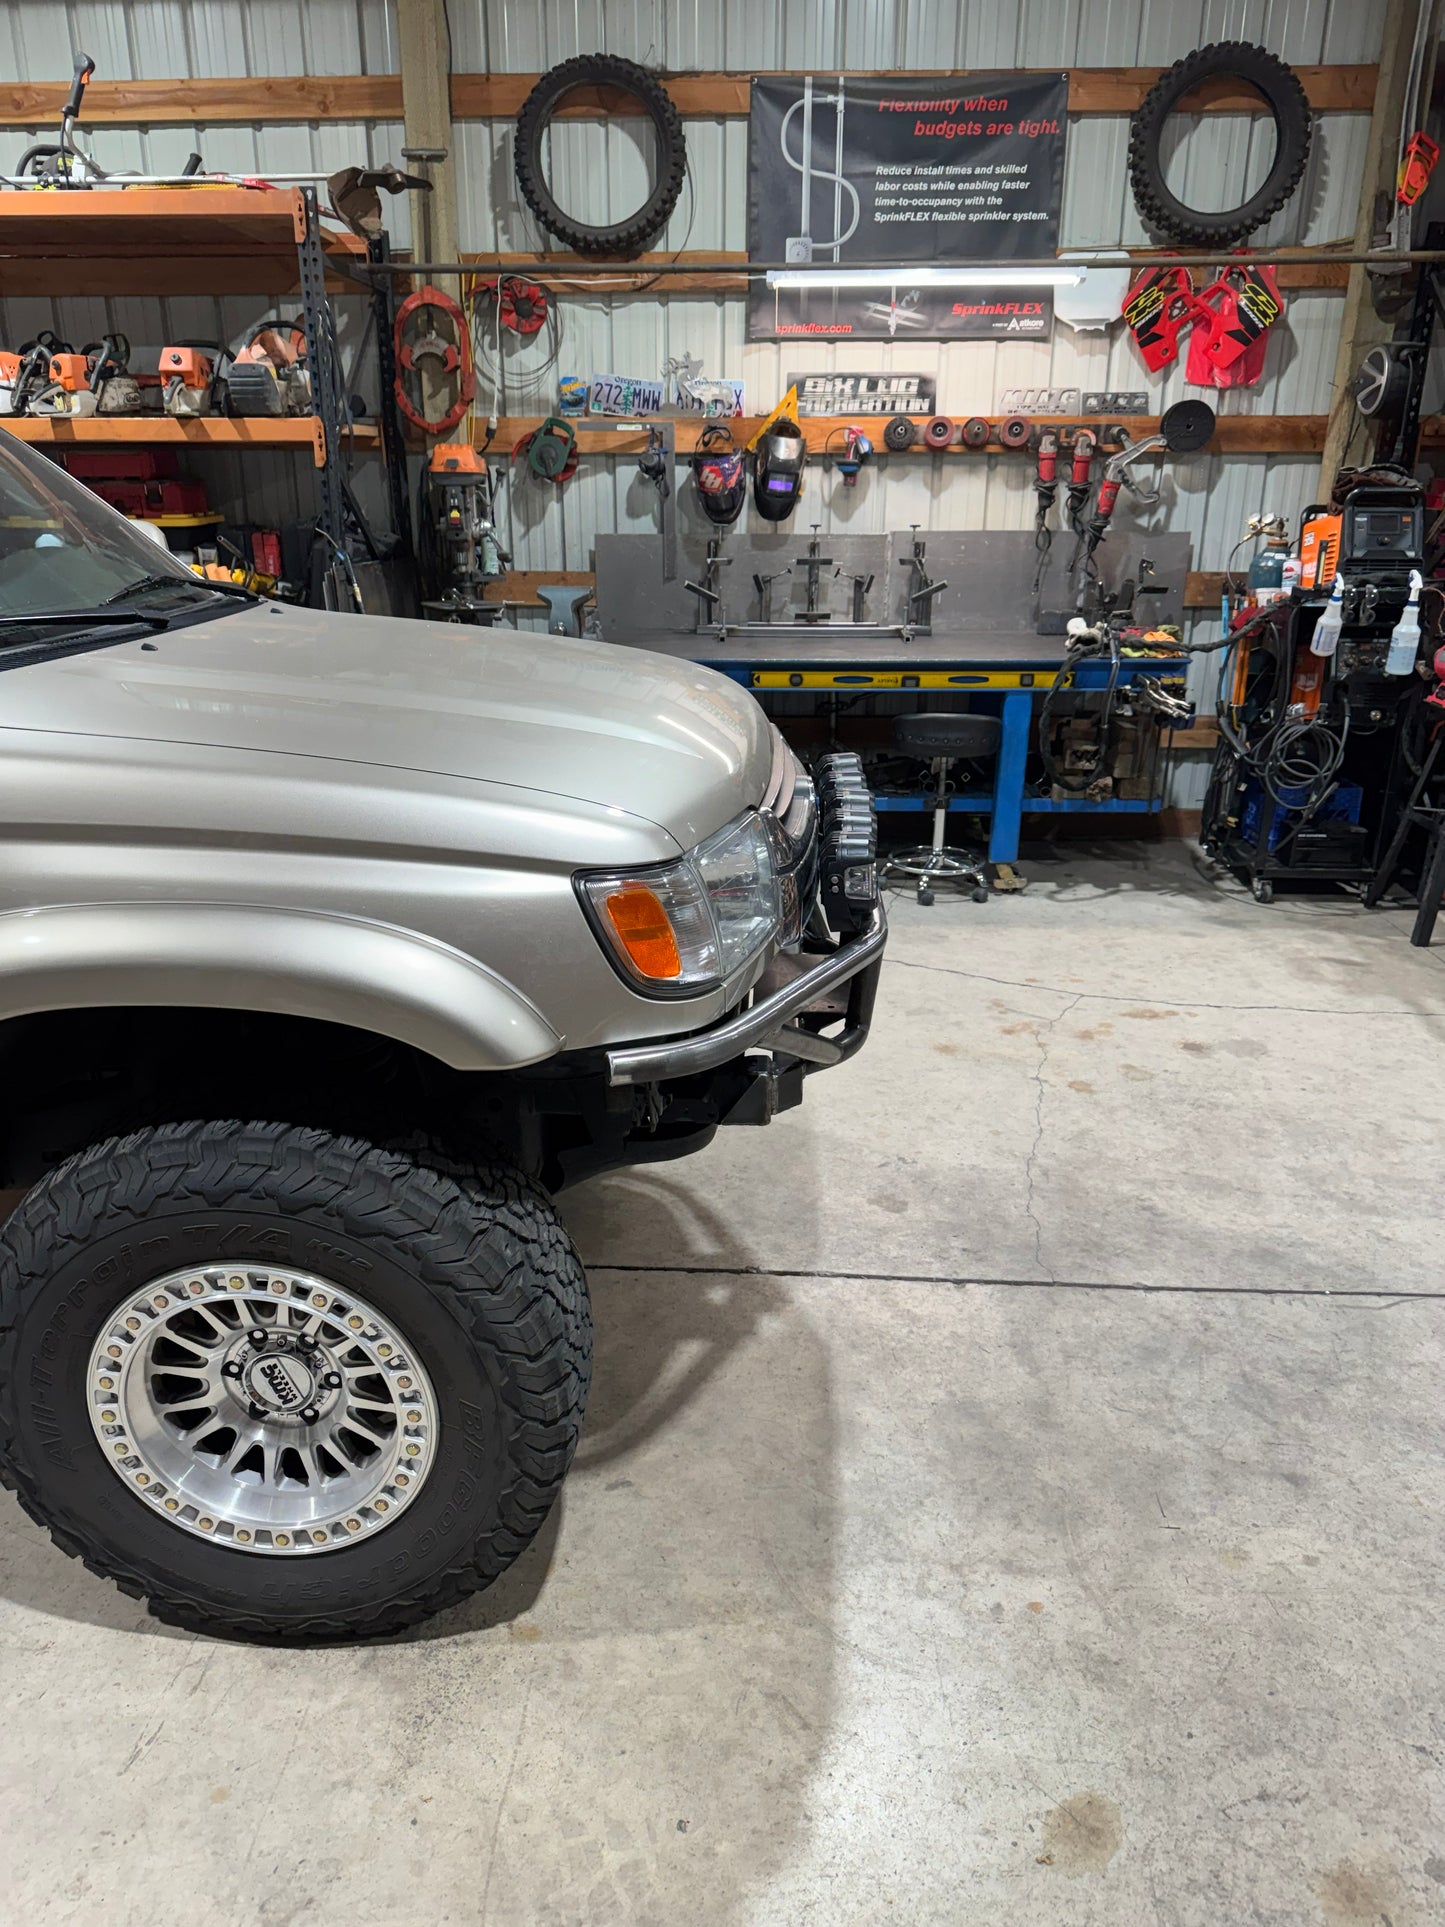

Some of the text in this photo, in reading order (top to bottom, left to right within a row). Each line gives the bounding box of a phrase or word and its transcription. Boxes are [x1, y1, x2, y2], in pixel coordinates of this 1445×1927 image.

[964, 96, 1008, 112] when
[914, 119, 1061, 139] budgets are tight.
[875, 164, 1028, 175] Reduce install times and skilled
[875, 180, 1030, 192] labor costs while enabling faster
[874, 196, 1003, 207] time-to-occupancy with the
[873, 211, 1049, 223] SprinkFLEX flexible sprinkler system.
[951, 302, 1045, 317] SprinkFLEX
[775, 323, 852, 335] sprinkflex.com
[614, 375, 642, 387] Oregon
[857, 377, 920, 395] LUG
[594, 382, 623, 406] 272
[632, 386, 662, 412] MWW
[182, 1223, 294, 1252] T/A
